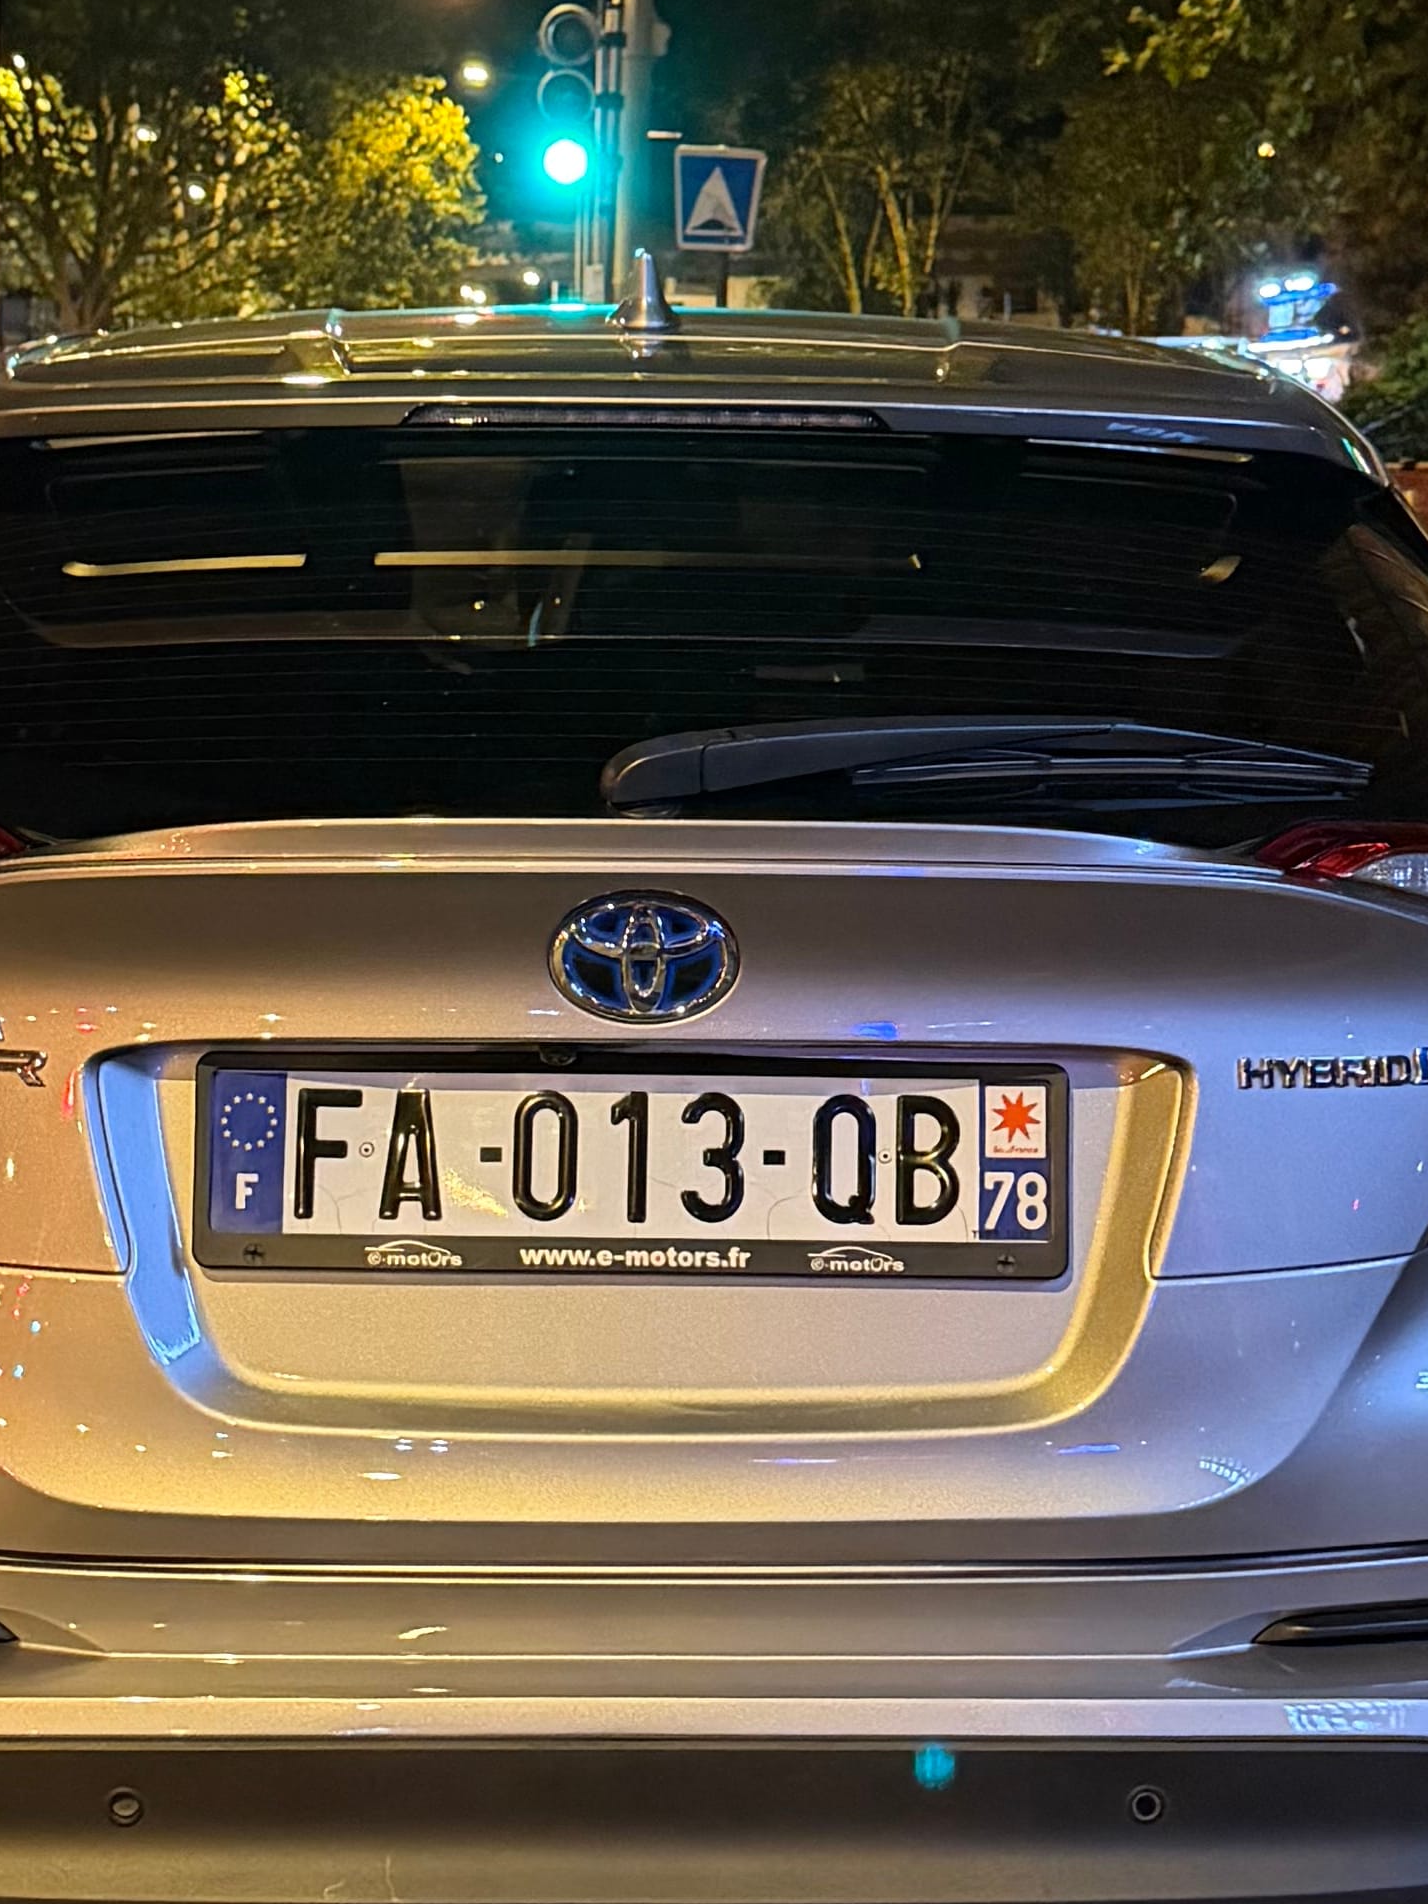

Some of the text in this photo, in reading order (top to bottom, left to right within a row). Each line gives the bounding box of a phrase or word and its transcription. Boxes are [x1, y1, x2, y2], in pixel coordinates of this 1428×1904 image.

[1237, 1055, 1412, 1089] HYBRID
[293, 1086, 961, 1226] FA-013-QB
[235, 1172, 259, 1210] F
[983, 1171, 1048, 1231] 78
[519, 1246, 752, 1268] www.e-motors.fr
